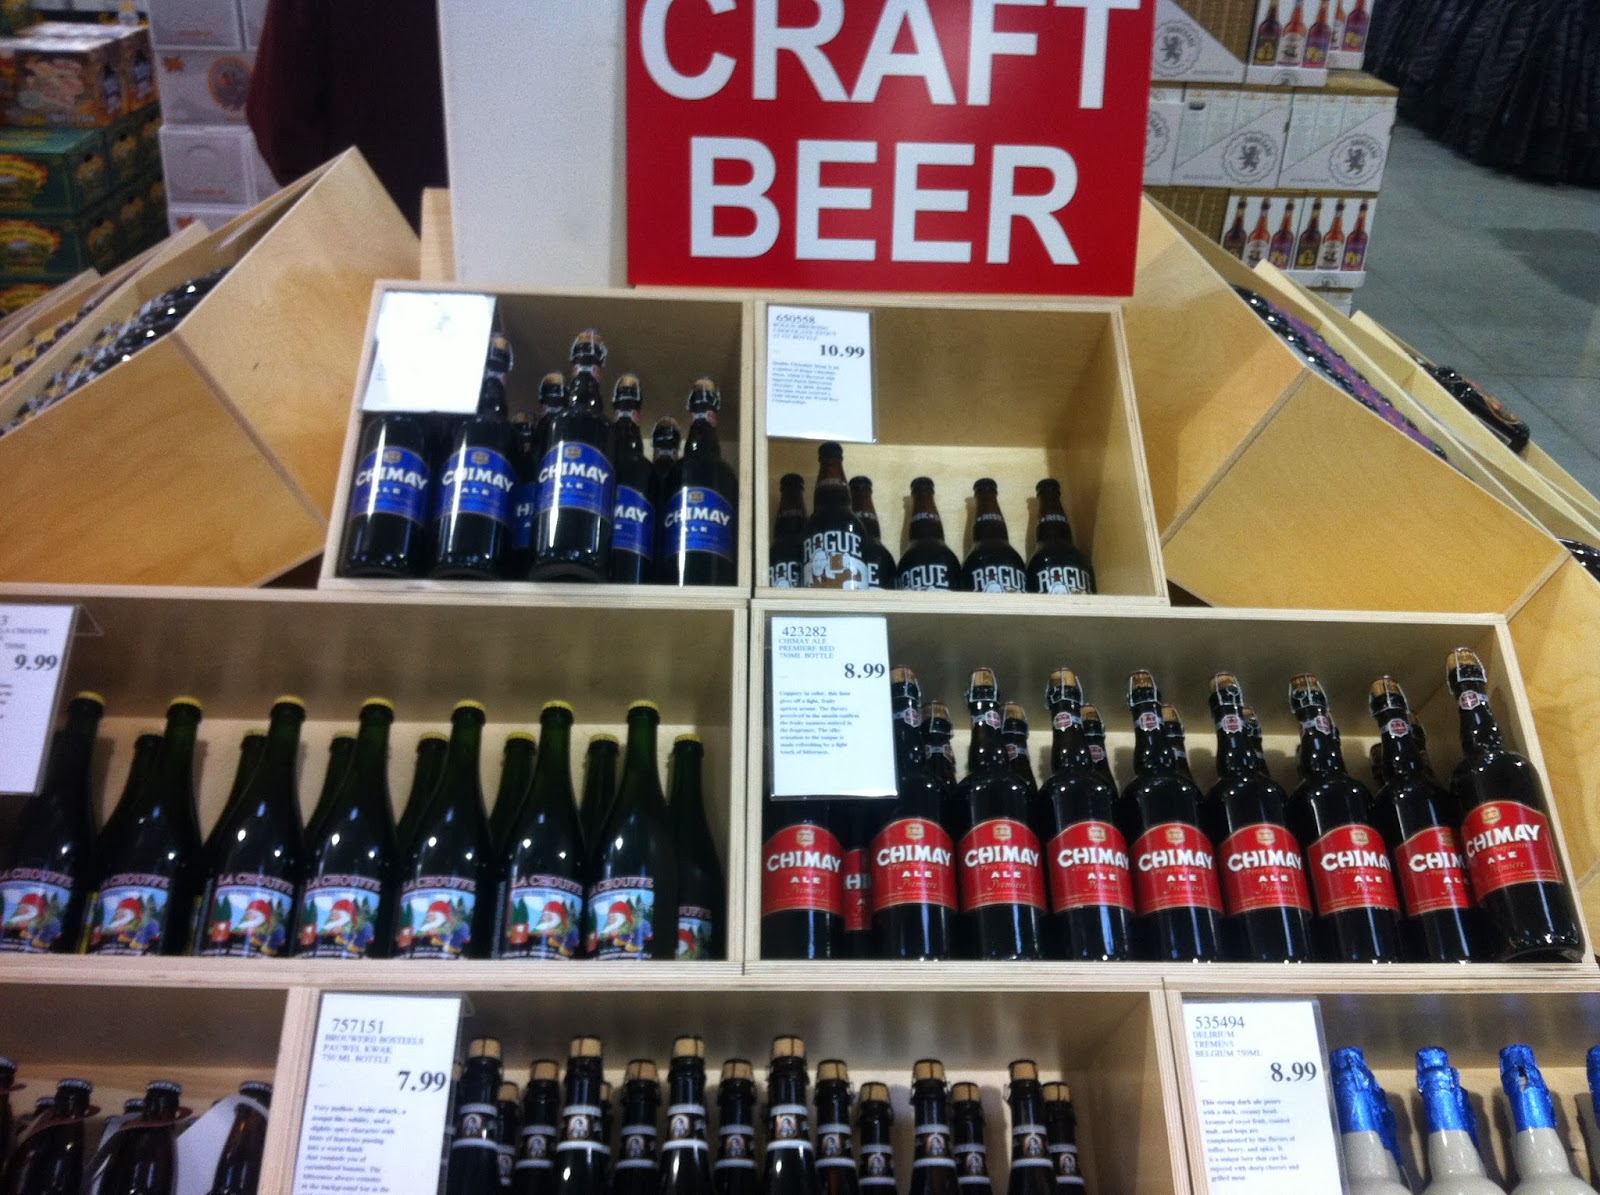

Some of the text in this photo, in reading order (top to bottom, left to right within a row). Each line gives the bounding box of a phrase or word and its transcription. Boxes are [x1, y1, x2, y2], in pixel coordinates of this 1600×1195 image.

[640, 0, 1140, 108] CRAFT
[690, 136, 1080, 265] BEER
[820, 344, 865, 358] 10.99
[356, 467, 428, 490] CHIMAY
[538, 462, 609, 484] CHIMAY
[461, 487, 489, 496] ALE
[613, 505, 648, 523] MAY
[664, 507, 731, 527] CHIMAY
[803, 530, 863, 563] ROGUE
[769, 561, 800, 586] ROG
[898, 564, 949, 587] OGUE
[782, 626, 827, 637] 423282
[12, 654, 58, 671] 9.99
[844, 663, 886, 679] 8.99
[1466, 824, 1541, 858] CHIMAY
[767, 851, 841, 872] CHIMAY
[877, 844, 952, 867] CHIMAY
[964, 845, 1040, 868] CHIMAY
[1057, 847, 1130, 871] CHIMAY
[1138, 849, 1213, 872] CHIMAY
[1227, 849, 1302, 872] CHIMAY
[1408, 851, 1466, 872] CHIM
[1487, 850, 1518, 865] ALE
[790, 876, 821, 884] ALE
[902, 870, 932, 878] ALE
[991, 871, 1021, 879] ALE
[1088, 872, 1117, 881] ALE
[1166, 874, 1197, 882] ALE
[1258, 874, 1289, 882] ALE
[1353, 875, 1383, 883] ALE
[332, 1018, 385, 1034] 757151
[1195, 1015, 1245, 1029] 535494
[1193, 1030, 1235, 1038] DELIRIUM
[1194, 1040, 1235, 1048] TREMENS
[397, 1070, 447, 1092] 7.99
[1270, 1061, 1317, 1082] 8.99
